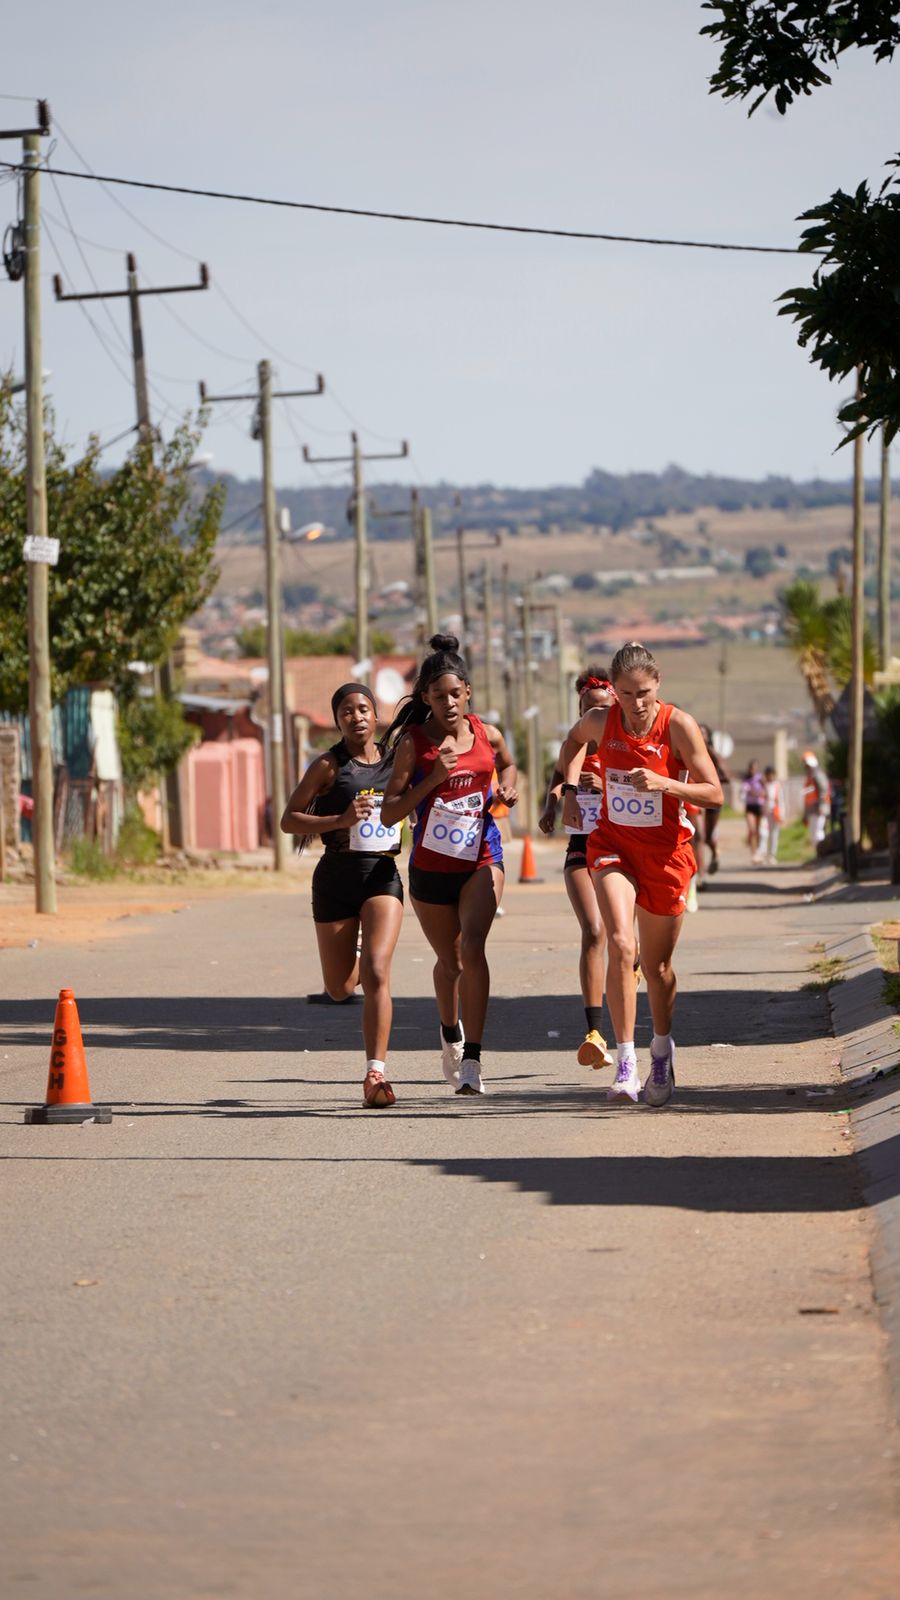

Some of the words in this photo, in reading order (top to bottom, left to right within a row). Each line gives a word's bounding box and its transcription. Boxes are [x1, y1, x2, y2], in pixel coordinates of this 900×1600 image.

[611, 796, 655, 815] 005
[432, 823, 476, 847] 008
[50, 1028, 67, 1090] GCH
